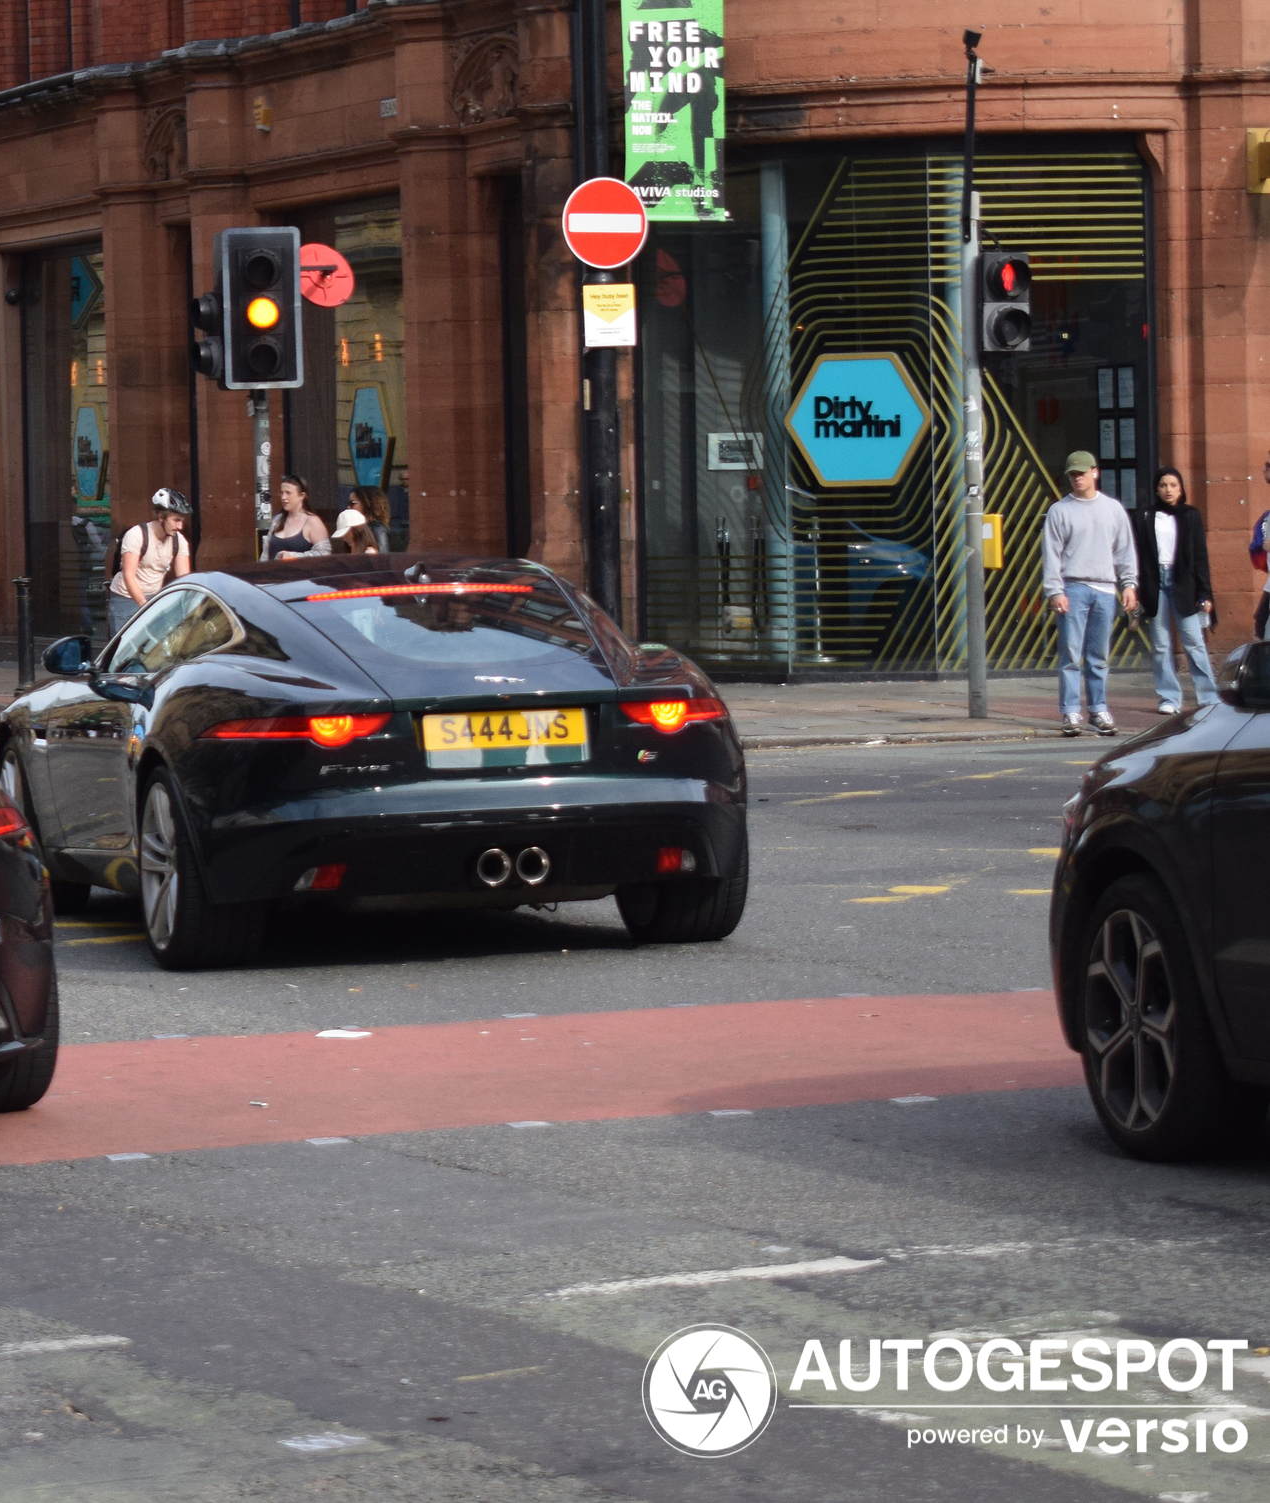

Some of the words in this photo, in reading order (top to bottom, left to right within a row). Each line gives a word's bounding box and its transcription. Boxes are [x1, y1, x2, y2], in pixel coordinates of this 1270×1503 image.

[629, 21, 700, 42] FREE
[647, 46, 719, 68] YOUR
[629, 71, 701, 93] MIND
[631, 100, 652, 111] THE
[631, 125, 652, 136] NOW
[632, 186, 671, 197] AVIVA
[675, 186, 719, 197] studios
[814, 396, 872, 421] Dirty
[814, 414, 901, 438] martini
[319, 764, 390, 775] F-TYPE
